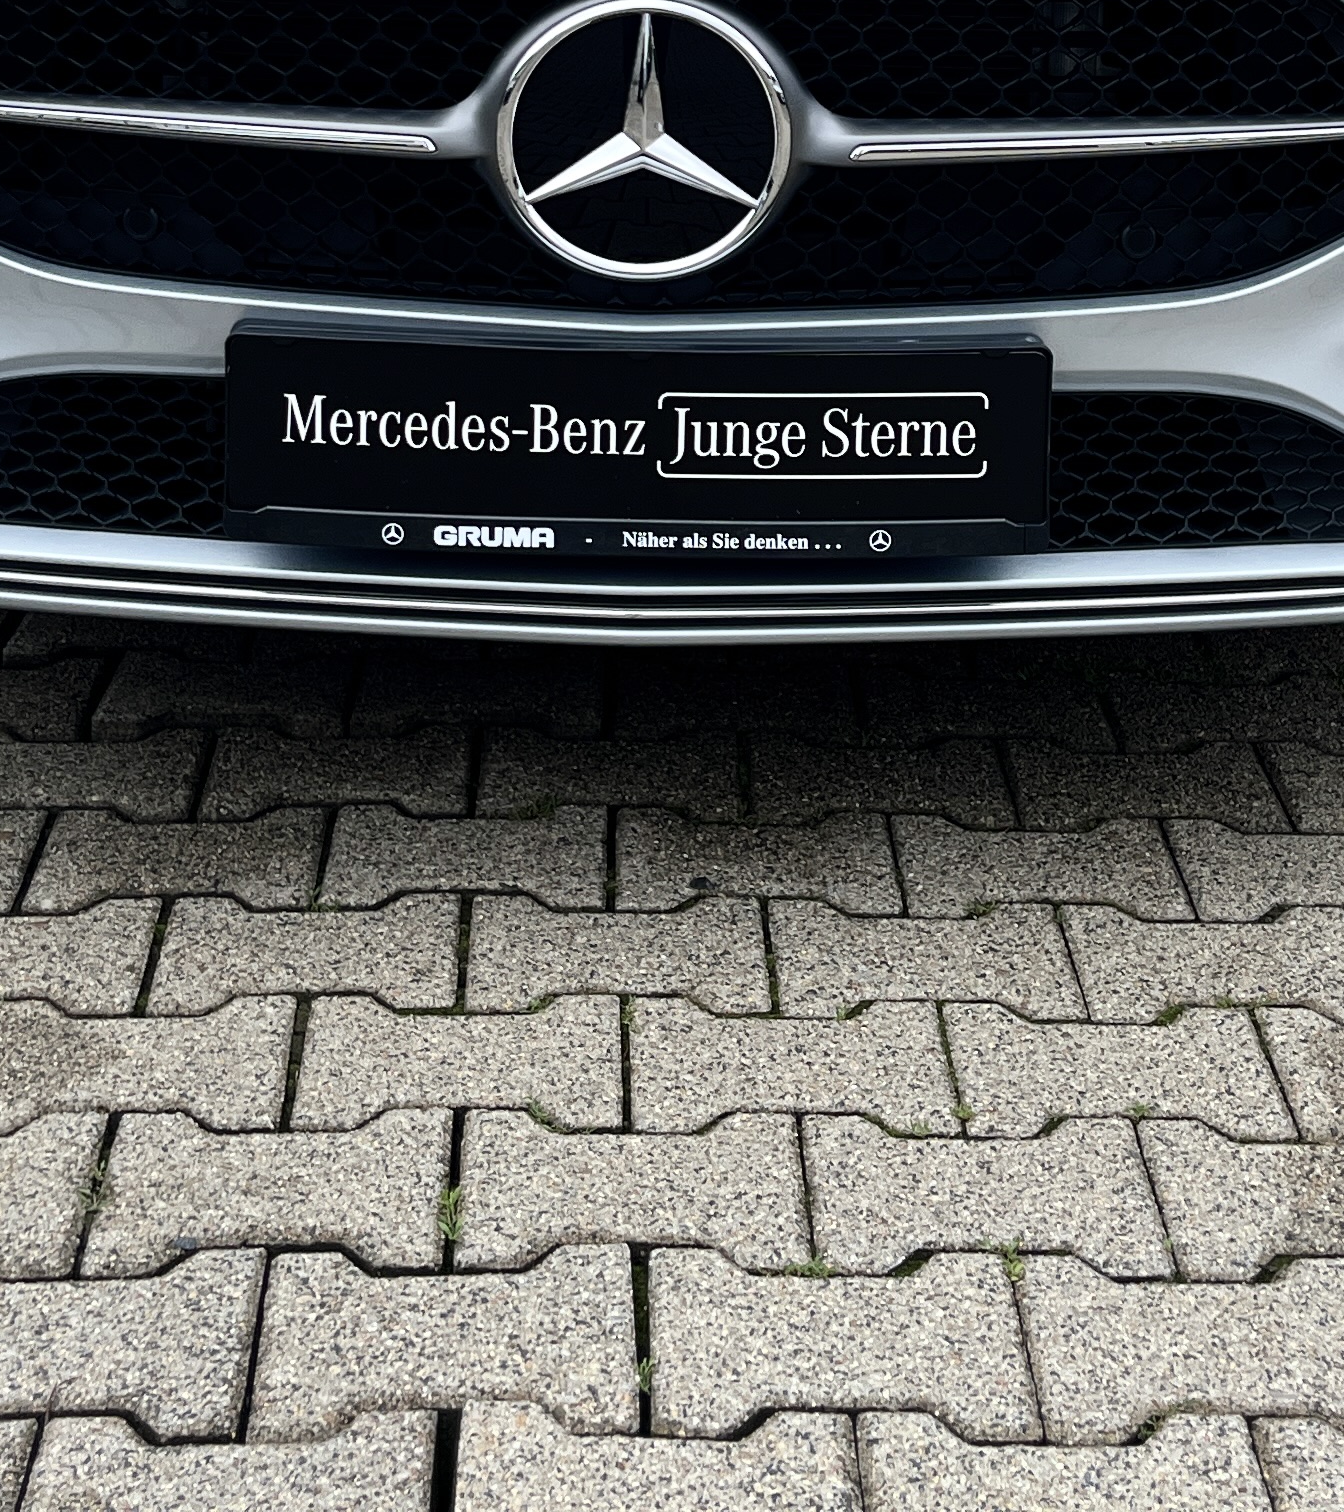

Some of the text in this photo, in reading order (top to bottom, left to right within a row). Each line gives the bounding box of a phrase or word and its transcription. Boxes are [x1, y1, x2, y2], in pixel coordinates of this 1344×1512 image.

[281, 393, 977, 470] Mercedes-Benz Junge Sterne
[433, 524, 555, 549] GRUMA
[621, 530, 679, 549] Näher
[682, 532, 708, 549] als
[712, 532, 740, 550] Sie
[744, 533, 809, 550] denken
